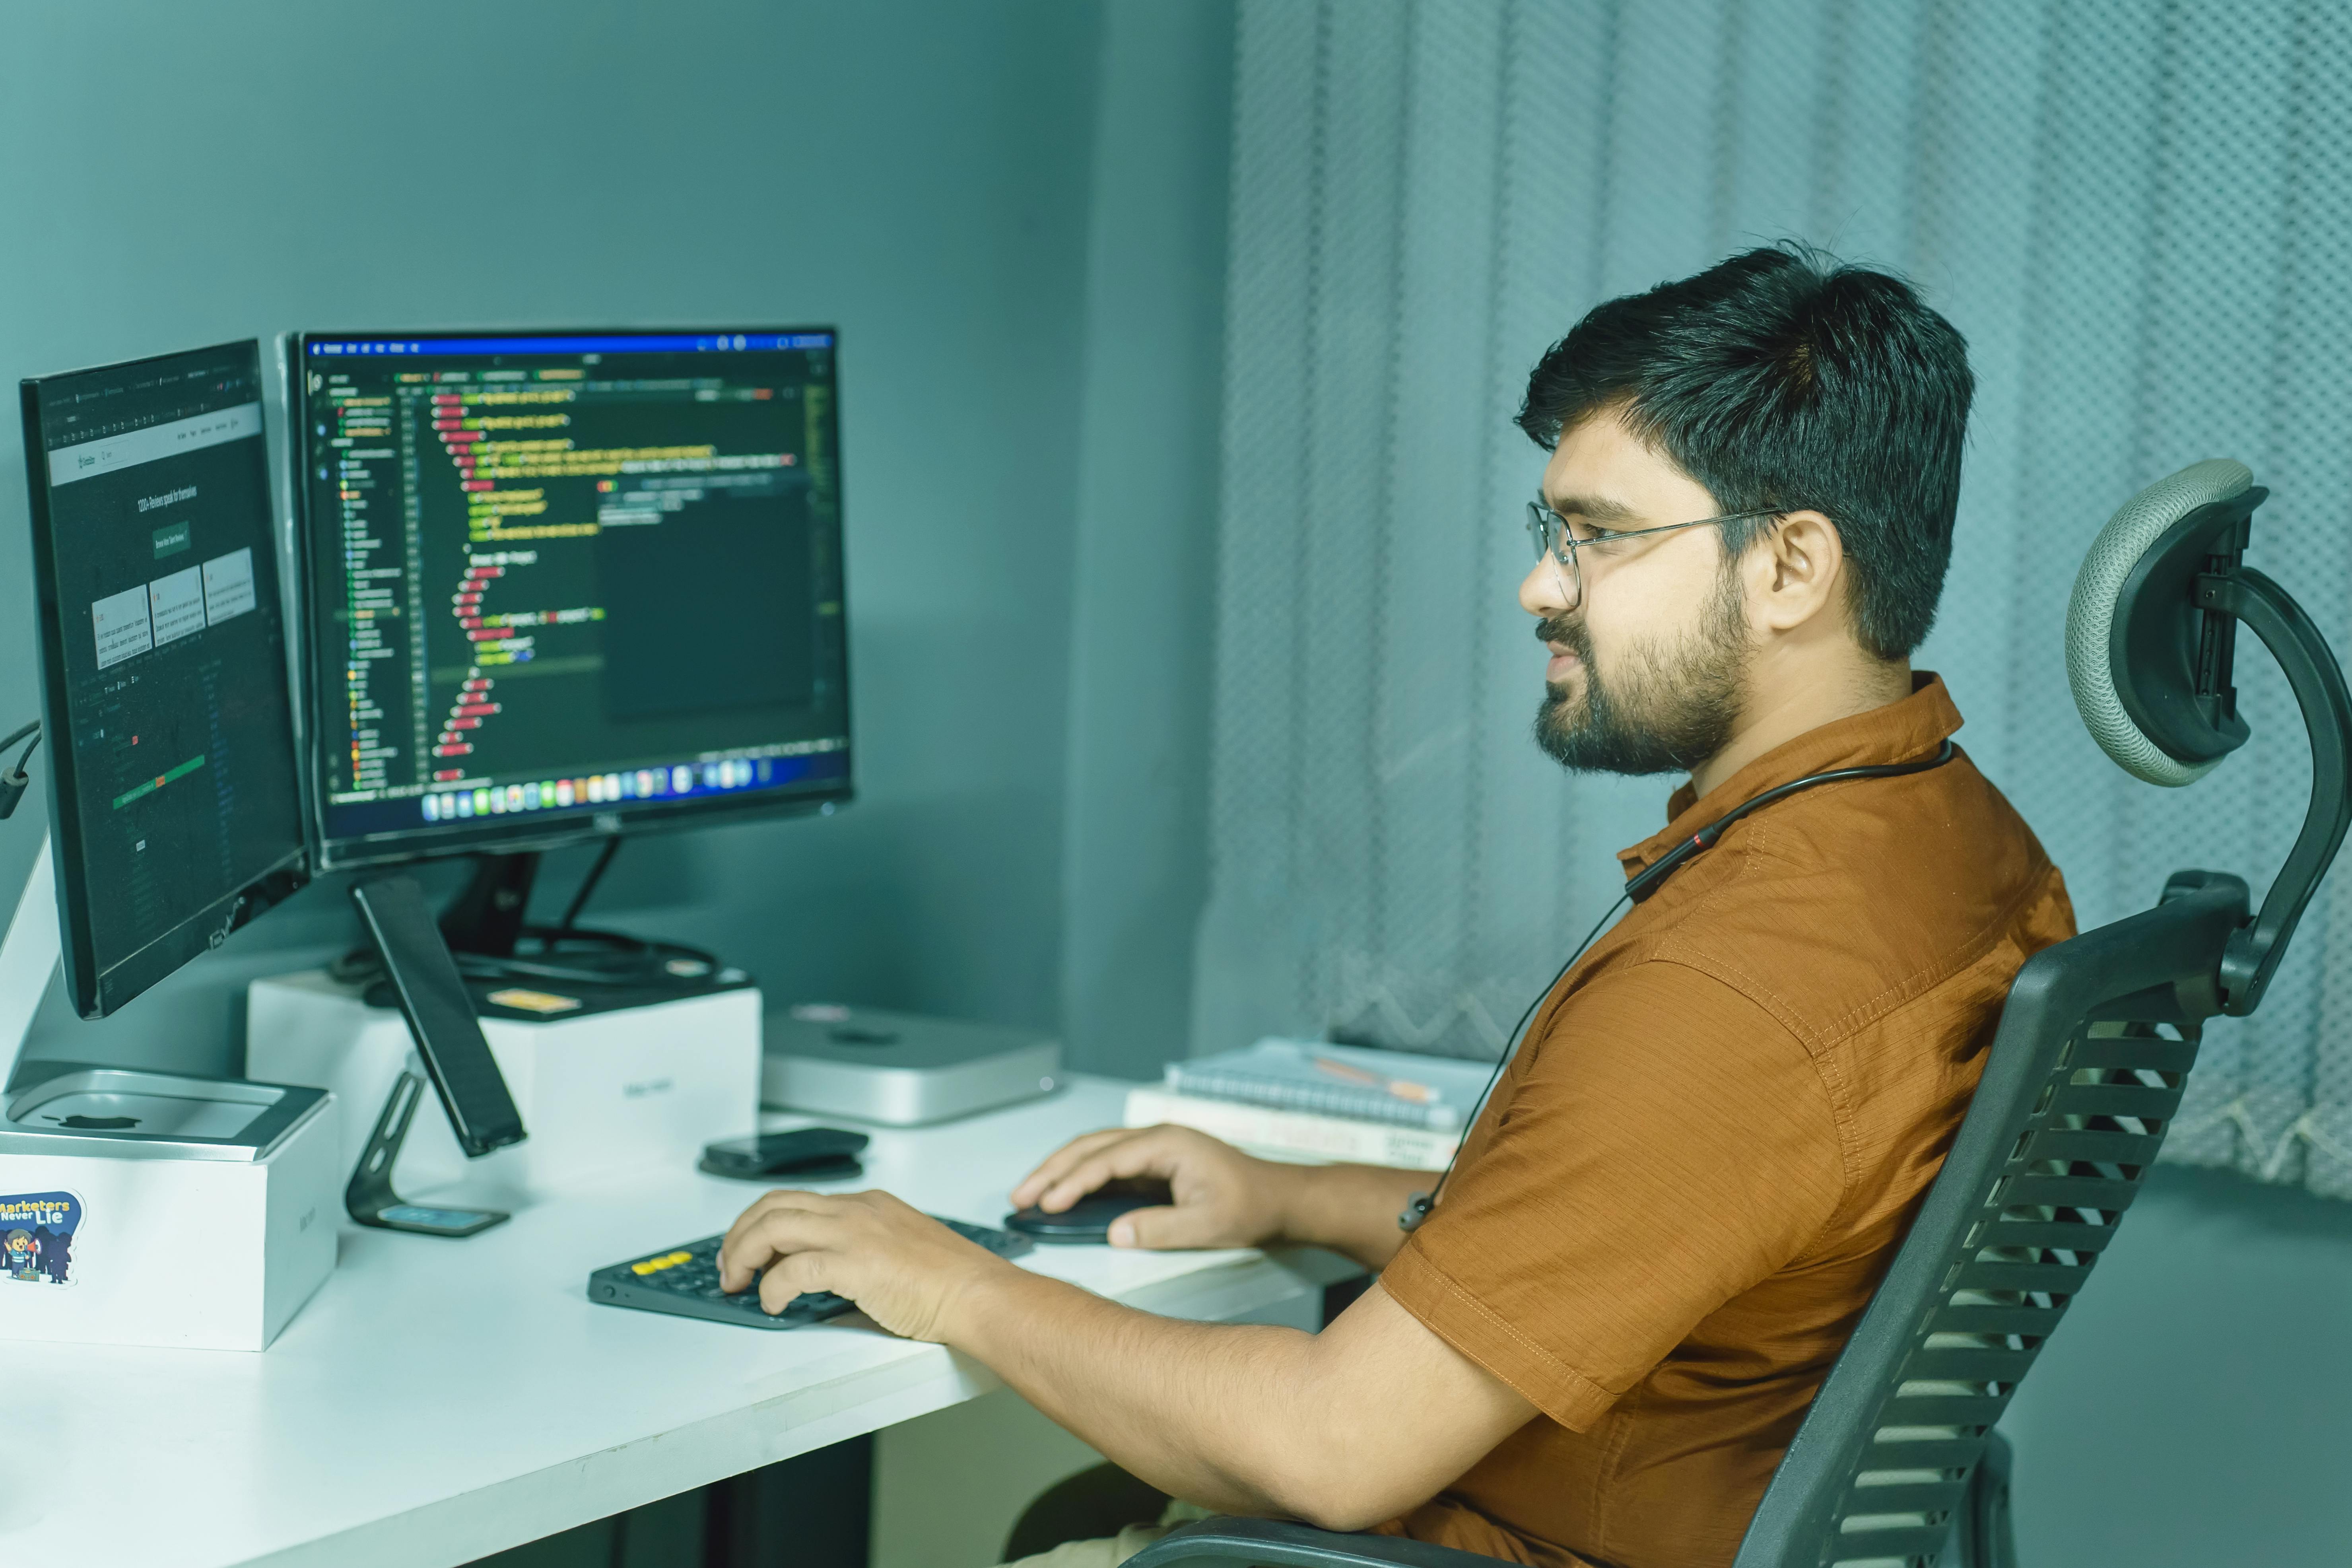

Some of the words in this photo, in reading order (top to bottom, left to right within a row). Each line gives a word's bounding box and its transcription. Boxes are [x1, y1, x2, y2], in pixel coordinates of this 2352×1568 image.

[138, 498, 149, 512] 1200+
[149, 495, 163, 509] Reviews
[163, 490, 174, 508] speak
[1, 1212, 33, 1221] Never
[35, 1208, 63, 1224] Lie
